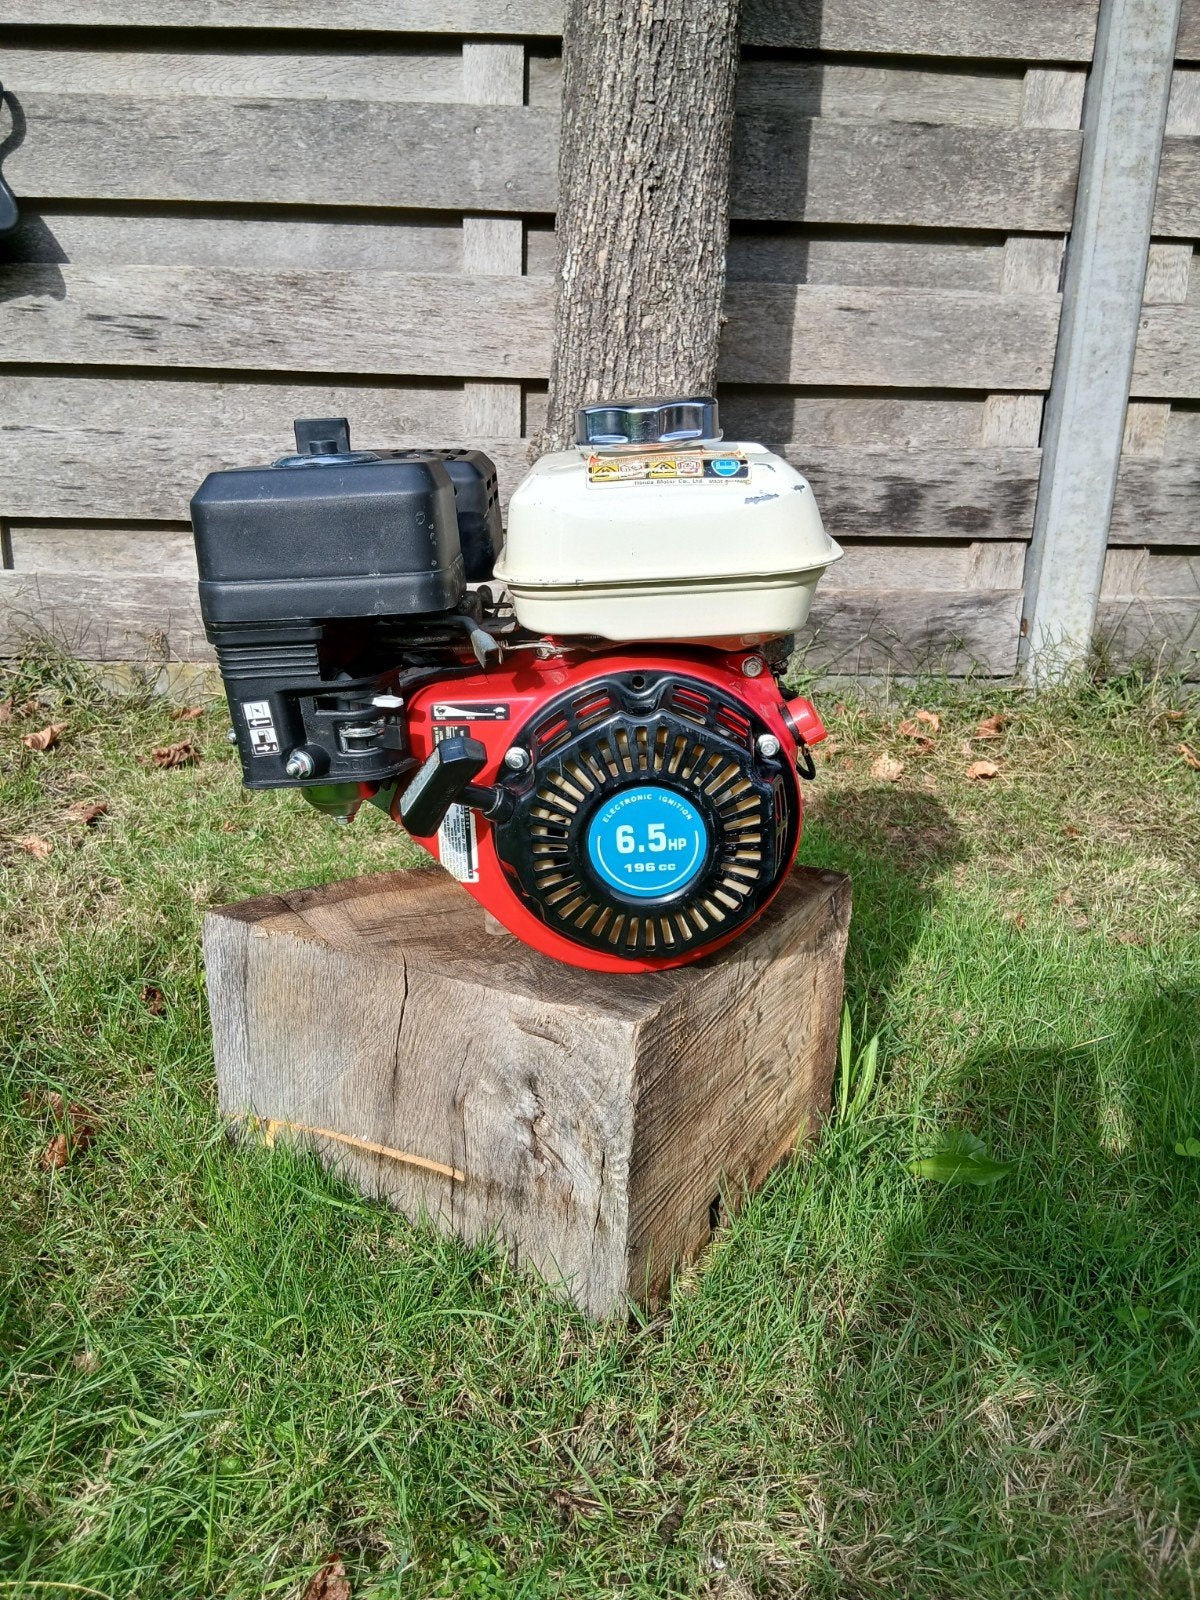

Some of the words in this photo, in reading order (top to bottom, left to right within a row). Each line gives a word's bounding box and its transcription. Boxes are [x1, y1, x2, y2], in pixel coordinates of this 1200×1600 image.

[602, 794, 653, 823] ELECTRONIC
[659, 795, 693, 821] IGNITION
[616, 823, 667, 854] 6.5
[668, 838, 687, 851] HP
[624, 863, 655, 873] 196
[658, 863, 676, 871] cc
